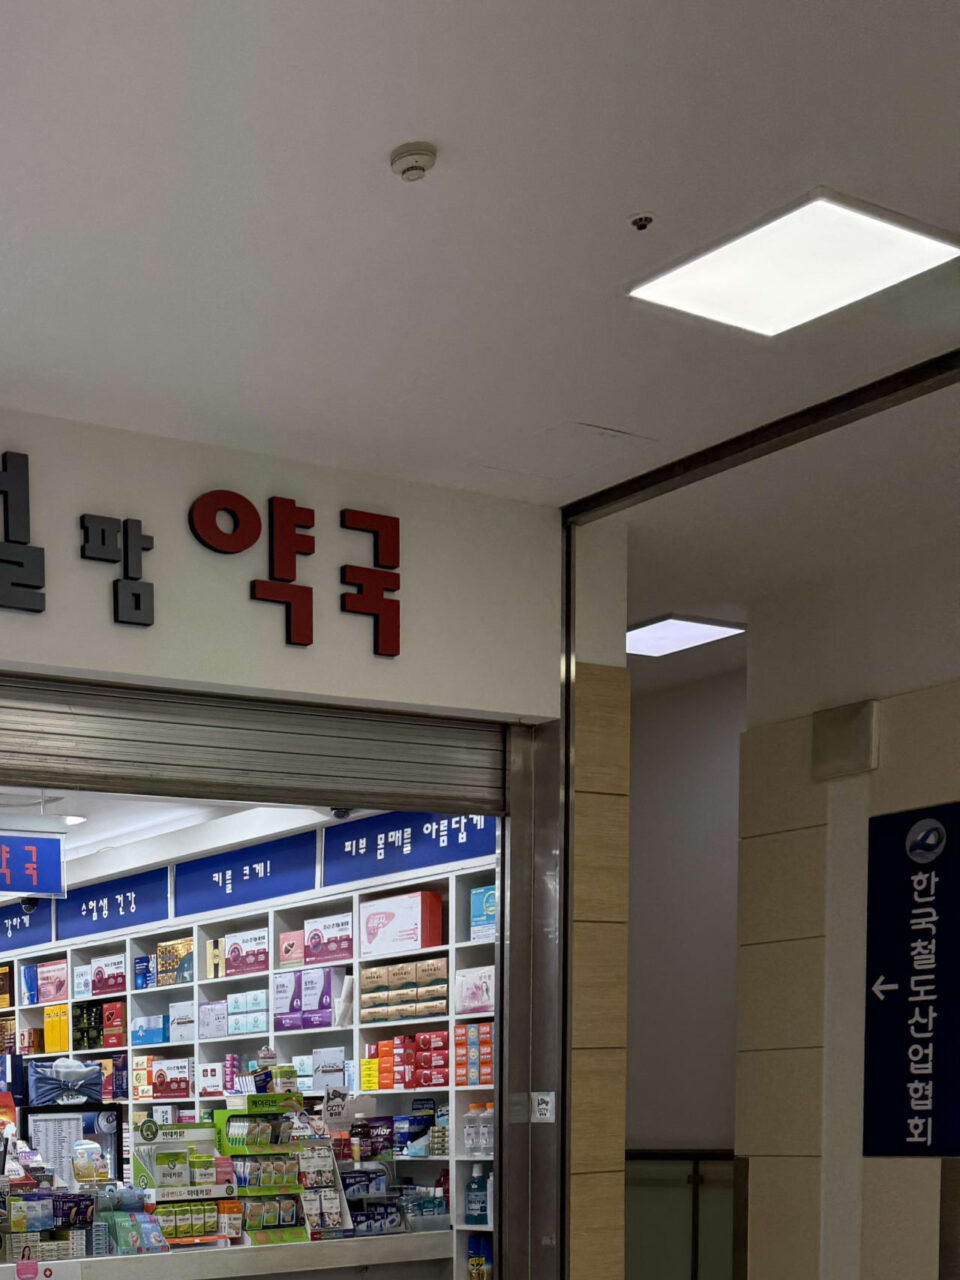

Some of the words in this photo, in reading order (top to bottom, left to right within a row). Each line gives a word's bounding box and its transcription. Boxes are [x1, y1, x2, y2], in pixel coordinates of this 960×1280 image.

[189, 489, 401, 657] 약국
[344, 837, 366, 856] 피부
[377, 828, 412, 860] 몸매를
[423, 814, 485, 847] 아름답게
[212, 869, 232, 894] 키를
[242, 860, 271, 880] 크게!
[81, 897, 108, 921] 수험생
[115, 891, 136, 916] 건강
[4, 915, 30, 938] 강하게
[906, 870, 940, 1147] 한국철도산업협회
